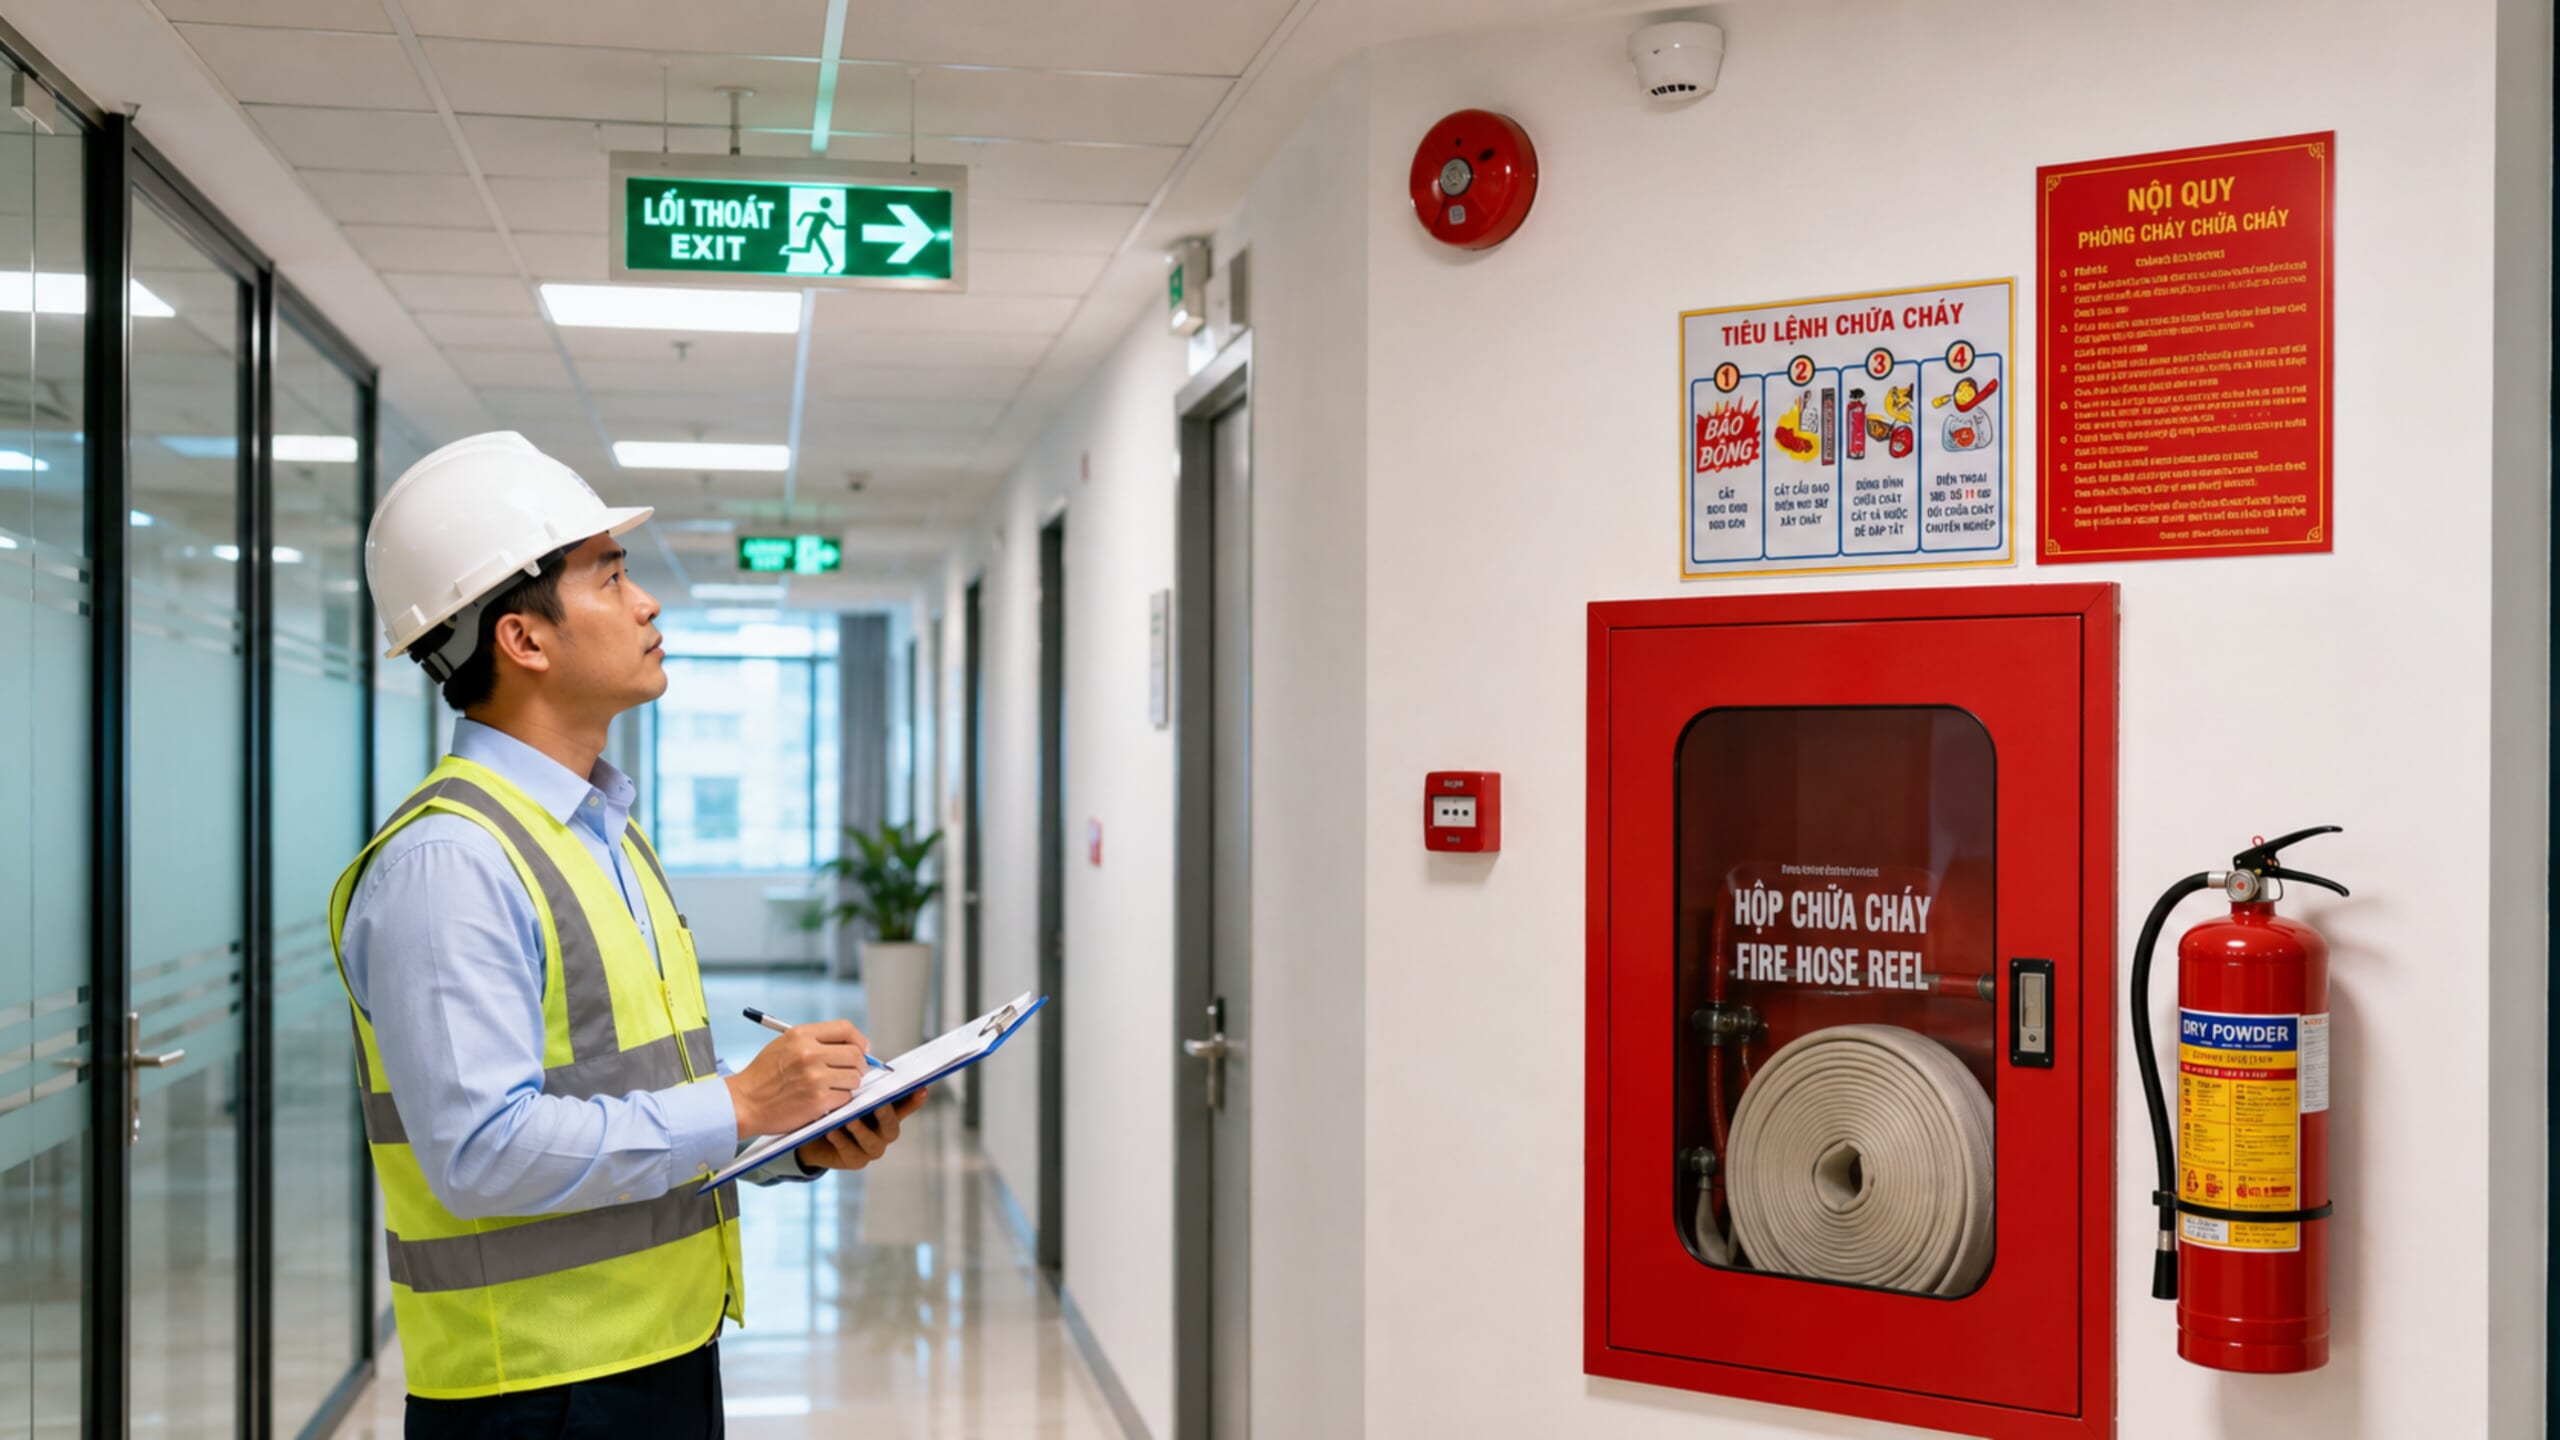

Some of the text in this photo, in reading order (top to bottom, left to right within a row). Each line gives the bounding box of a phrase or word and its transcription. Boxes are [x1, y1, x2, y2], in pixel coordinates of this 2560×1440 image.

[2127, 176, 2236, 215] NỘI QUY
[691, 194, 775, 229] THOÁT
[2243, 206, 2289, 231] CHÁY
[671, 233, 746, 261] EXIT
[1721, 298, 1964, 346] TIÊU LỆNH CHỮA CHÁY
[1873, 353, 1887, 374] 3
[1952, 346, 1967, 368] 4
[1720, 367, 1731, 388] 1
[1795, 360, 1808, 381] 2
[1734, 879, 1932, 935] HỘP CHỮA CHÁY
[1736, 942, 1929, 991] FIRE HOSE REEL
[2183, 1019, 2289, 1043] DRY POWDER
